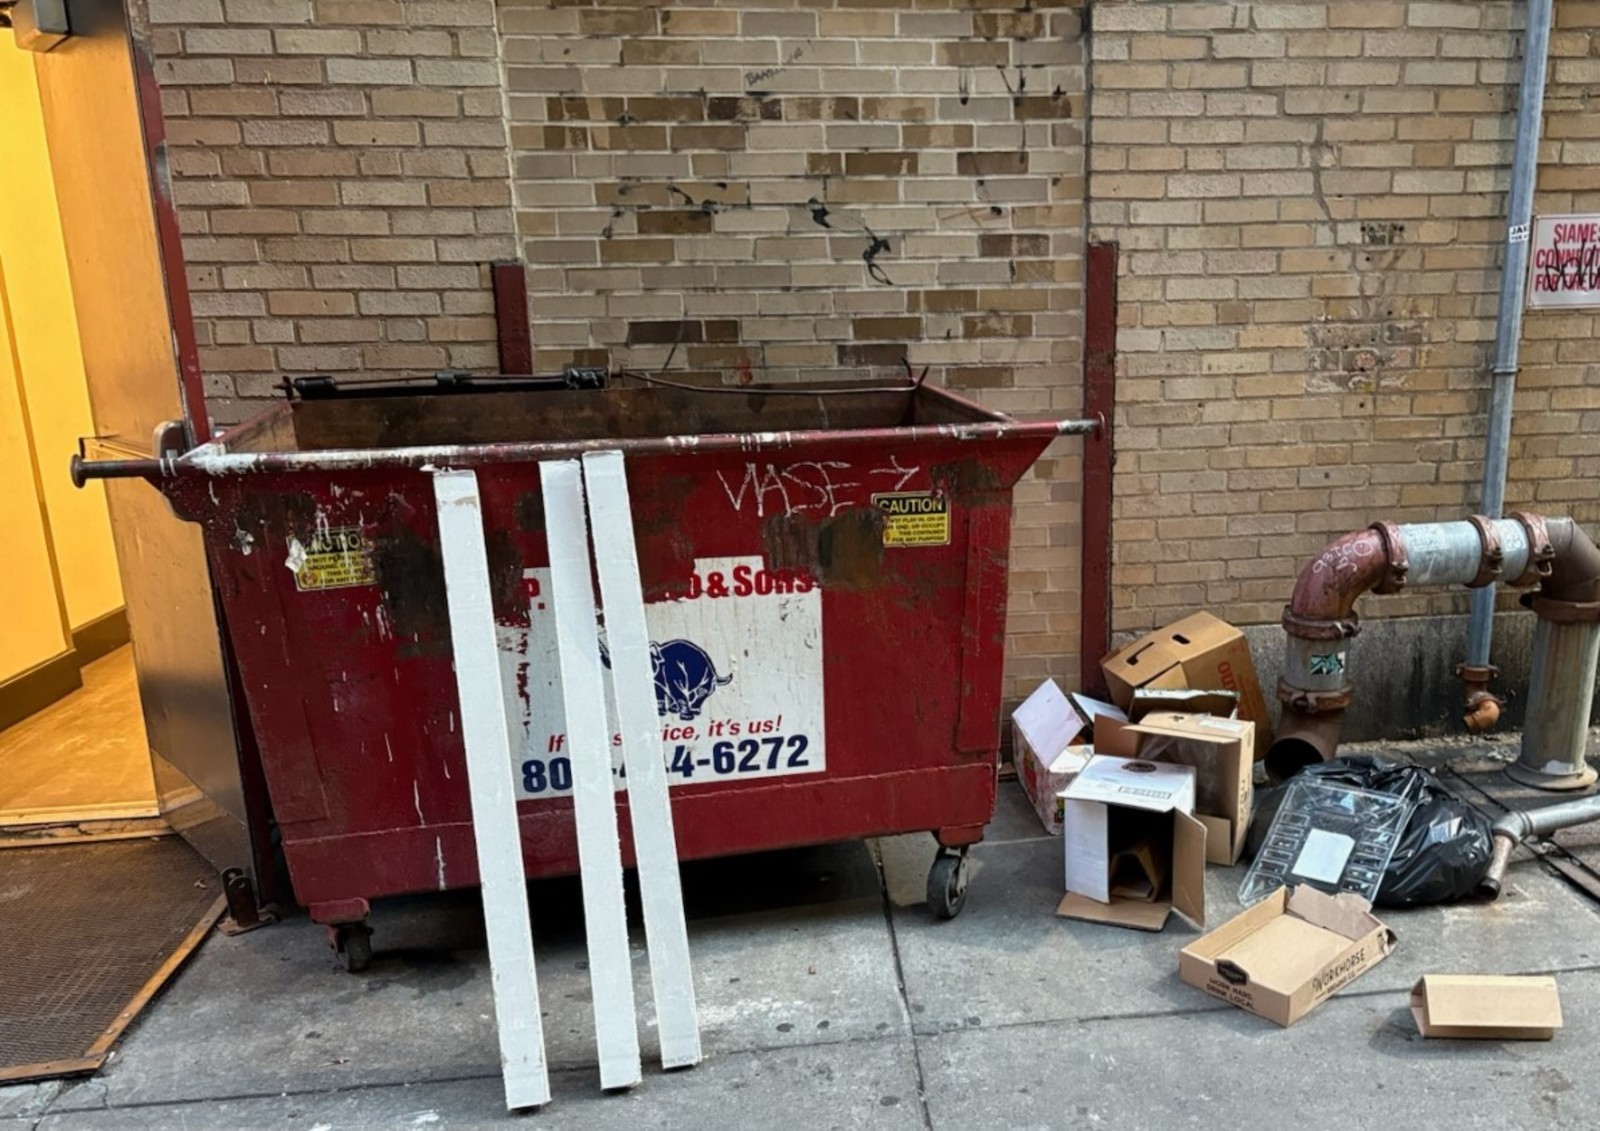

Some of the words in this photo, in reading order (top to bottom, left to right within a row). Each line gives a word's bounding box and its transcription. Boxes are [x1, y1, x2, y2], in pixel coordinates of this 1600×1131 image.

[1554, 223, 1600, 243] SIAME
[879, 498, 943, 513] CAUTION
[707, 572, 729, 598] &
[548, 734, 566, 753] If
[708, 719, 741, 737] it's
[749, 714, 782, 734] us!
[1312, 948, 1364, 992] WORKHORSE
